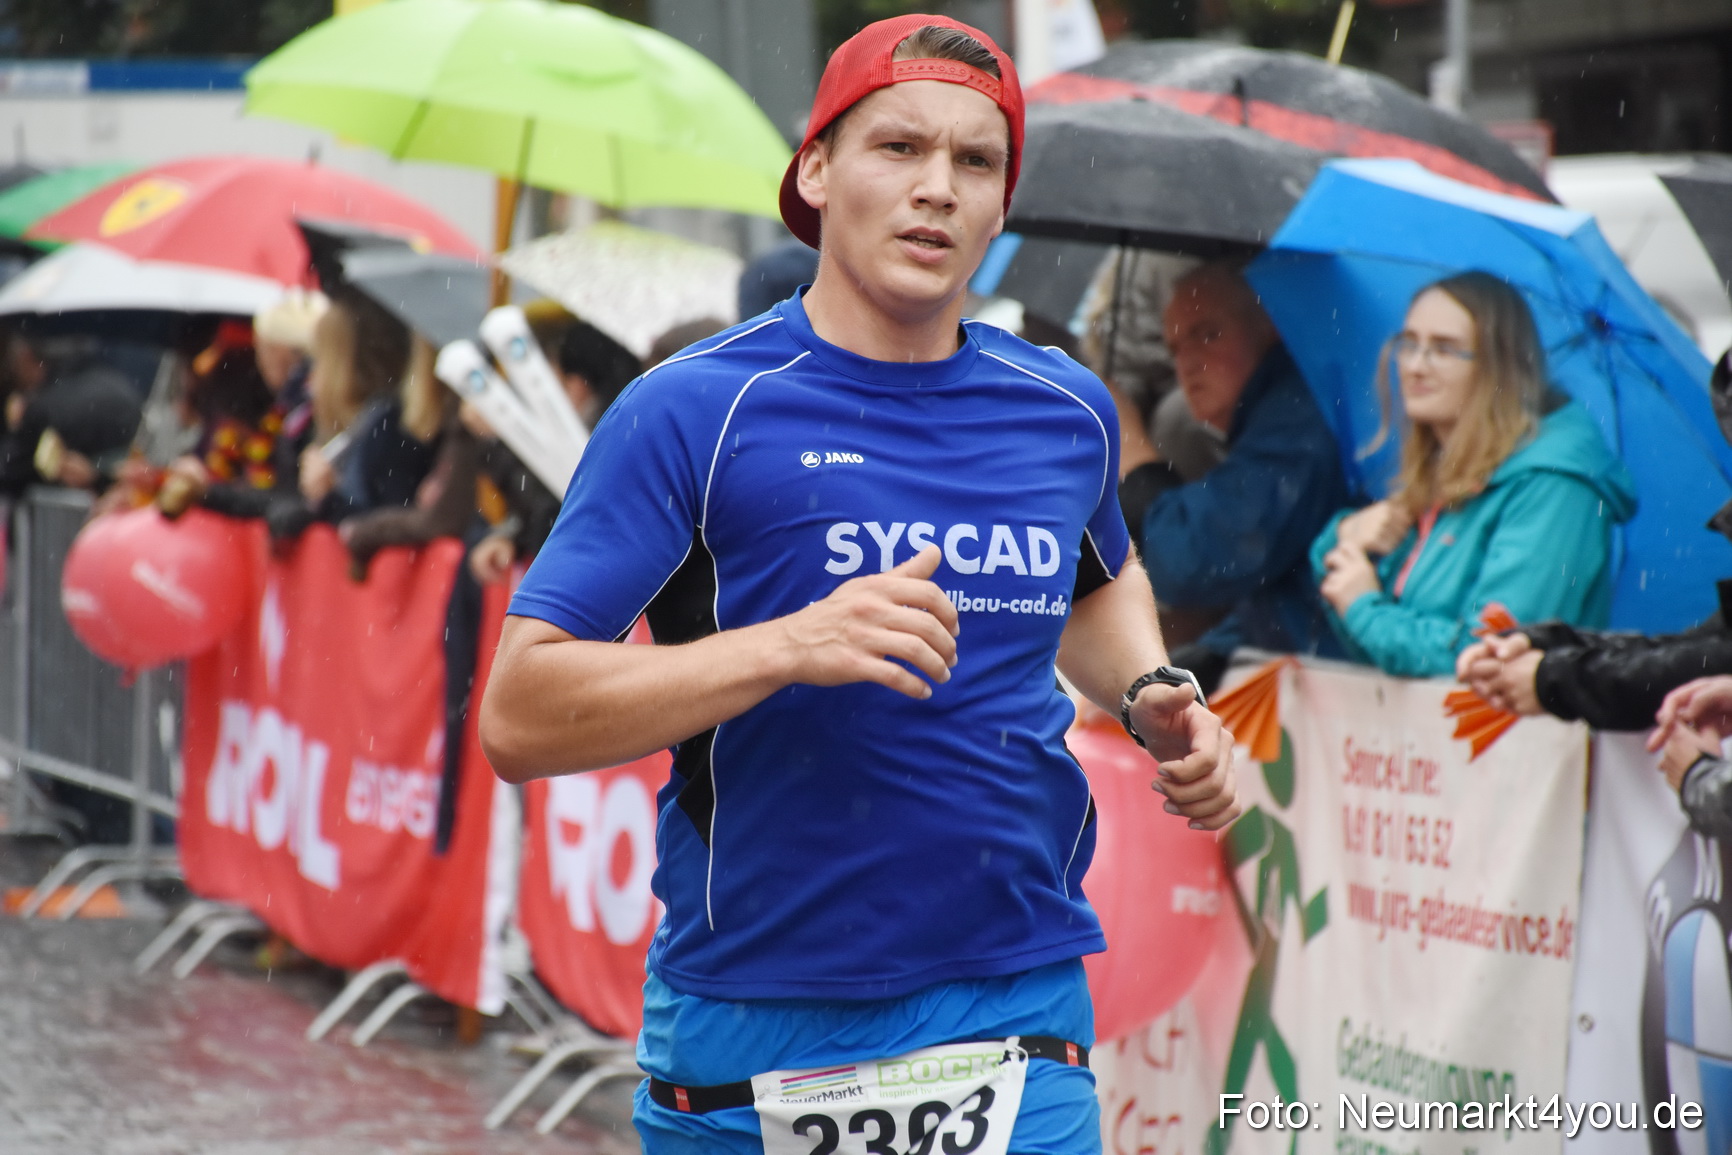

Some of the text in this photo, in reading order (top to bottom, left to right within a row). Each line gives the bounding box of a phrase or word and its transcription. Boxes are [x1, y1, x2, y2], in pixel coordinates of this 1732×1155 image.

[825, 452, 864, 464] JAKO
[824, 521, 1061, 577] SYSCAD
[944, 590, 1067, 617] llbau-cad.de
